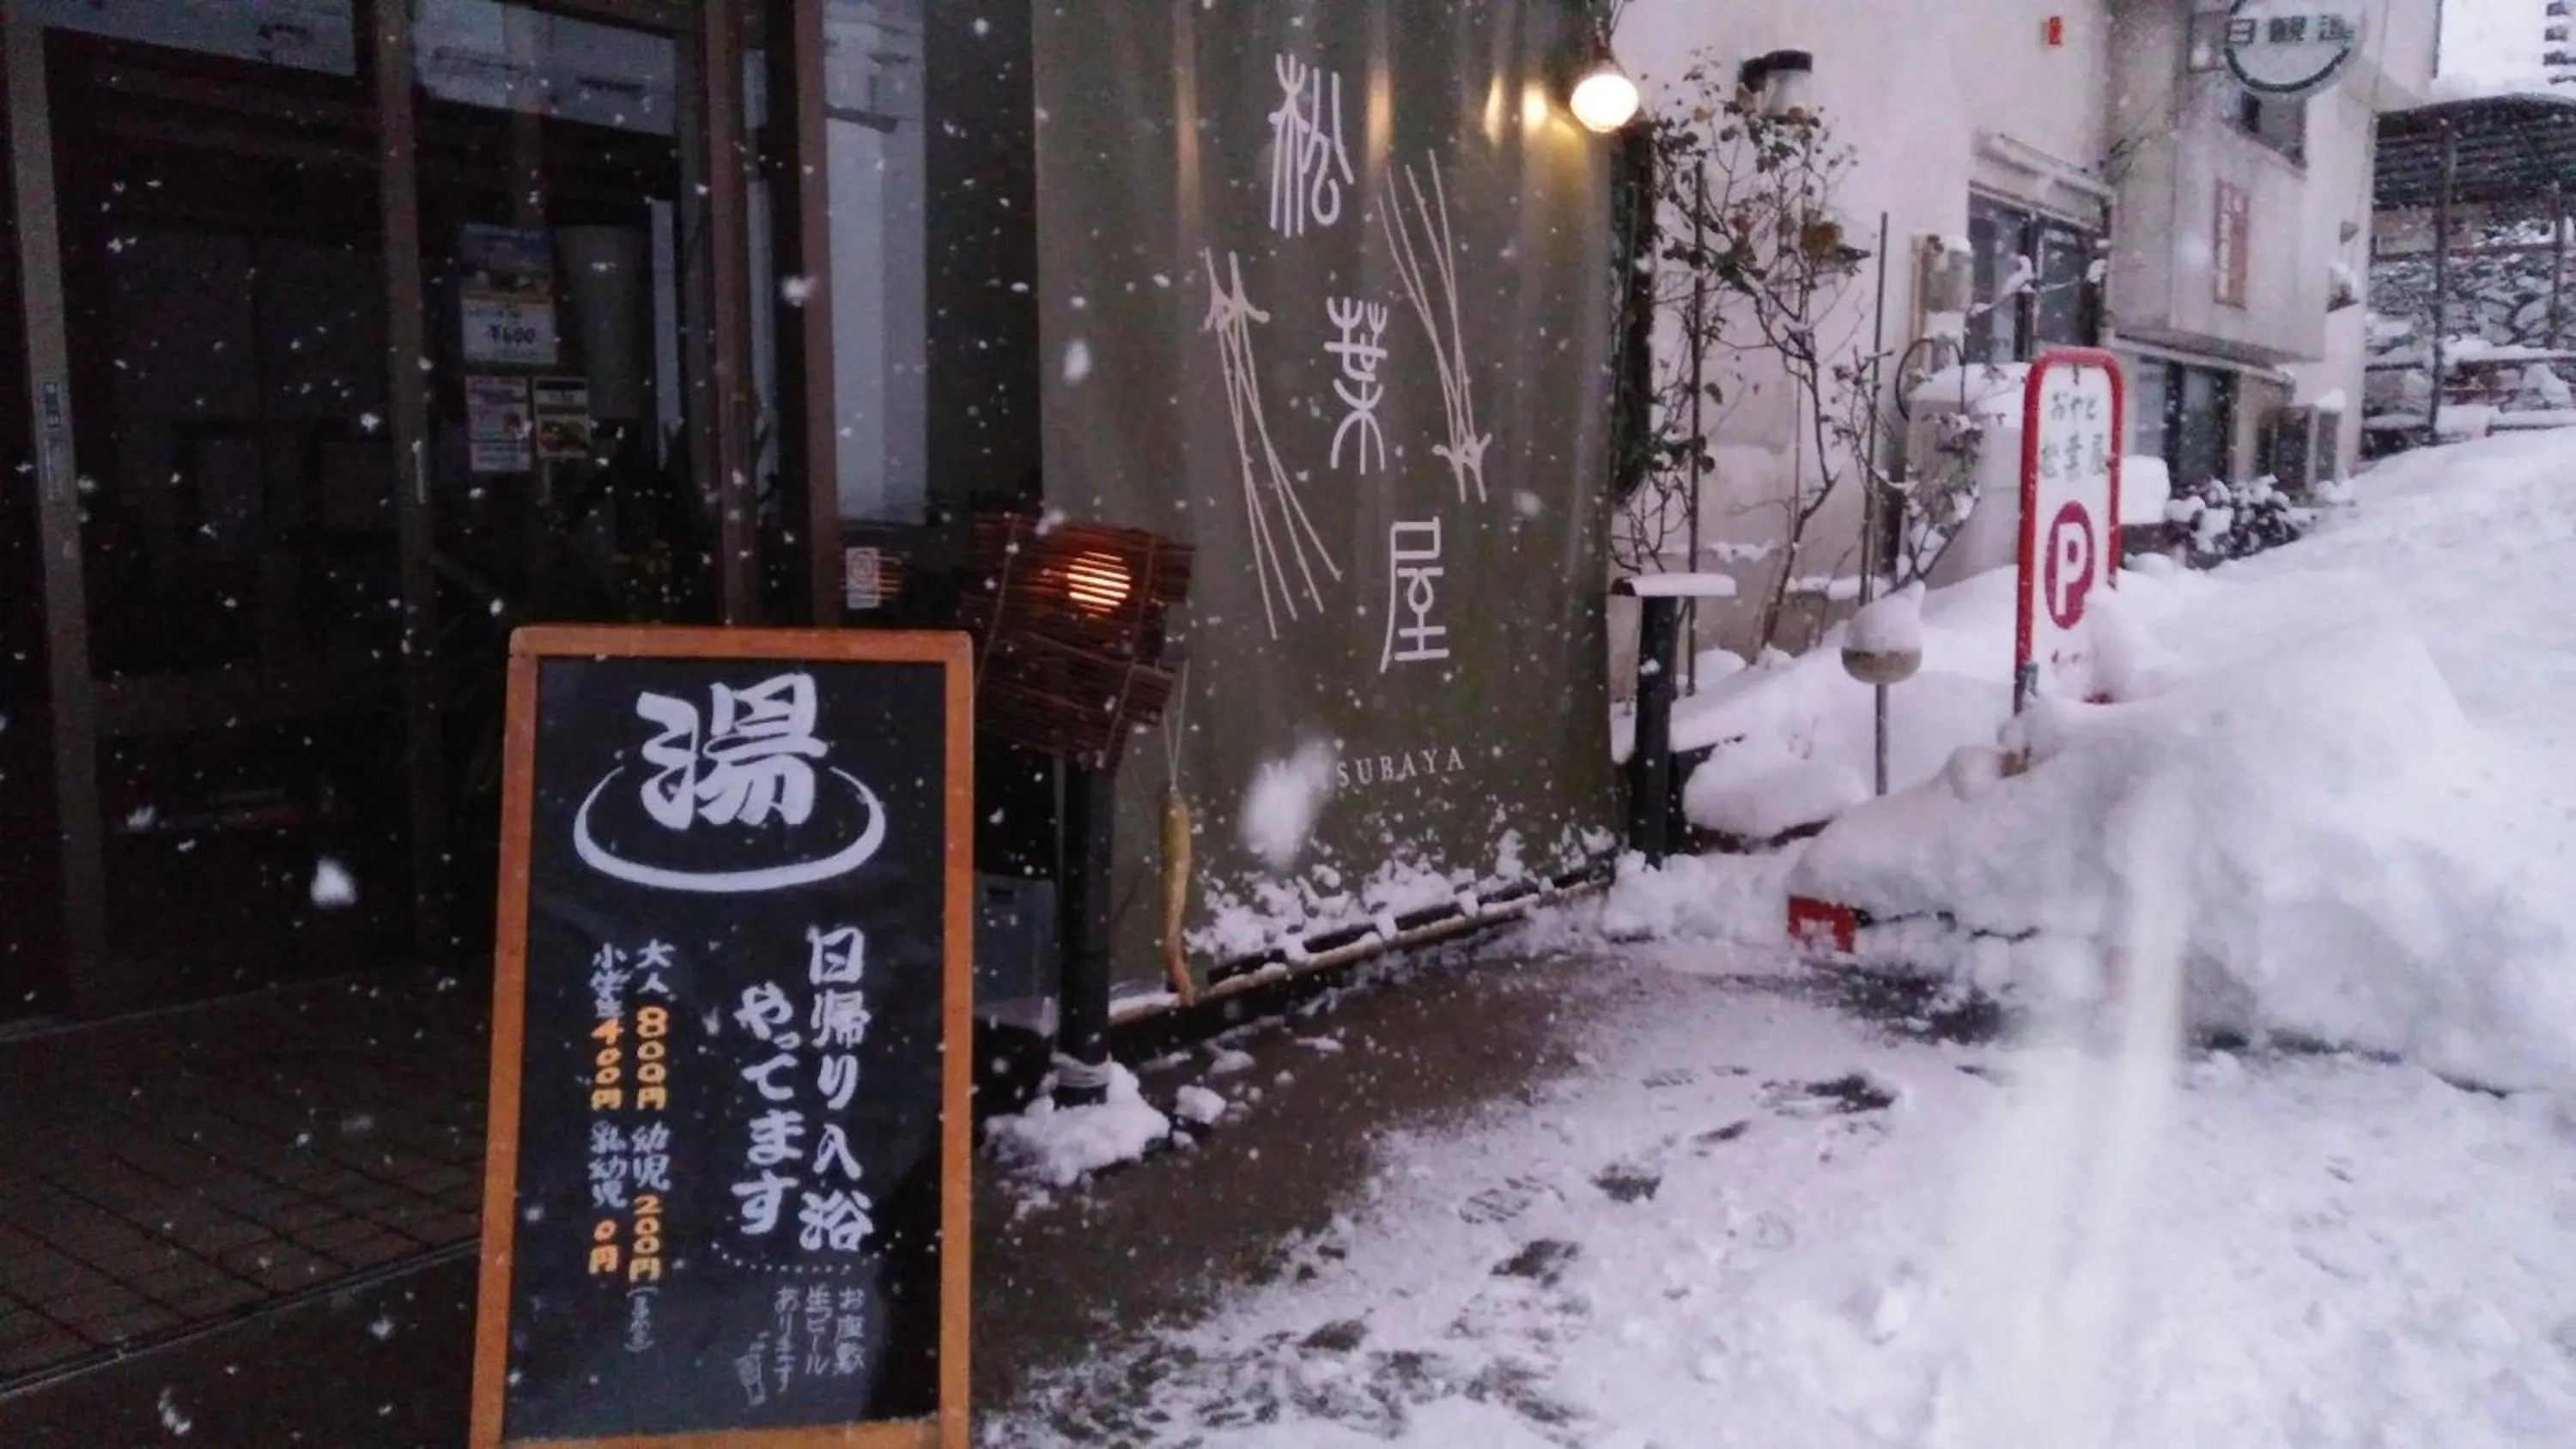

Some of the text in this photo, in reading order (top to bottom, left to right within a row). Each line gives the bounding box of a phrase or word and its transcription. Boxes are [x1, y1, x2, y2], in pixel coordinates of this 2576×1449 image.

[2056, 522, 2088, 616] P
[636, 672, 829, 830] 湯
[1262, 746, 1466, 792] MSUBAYA
[731, 979, 807, 1234] やってます
[798, 926, 875, 1252] 日帰り入浴
[773, 1285, 801, 1393] あります
[804, 1281, 835, 1375] 生ビール
